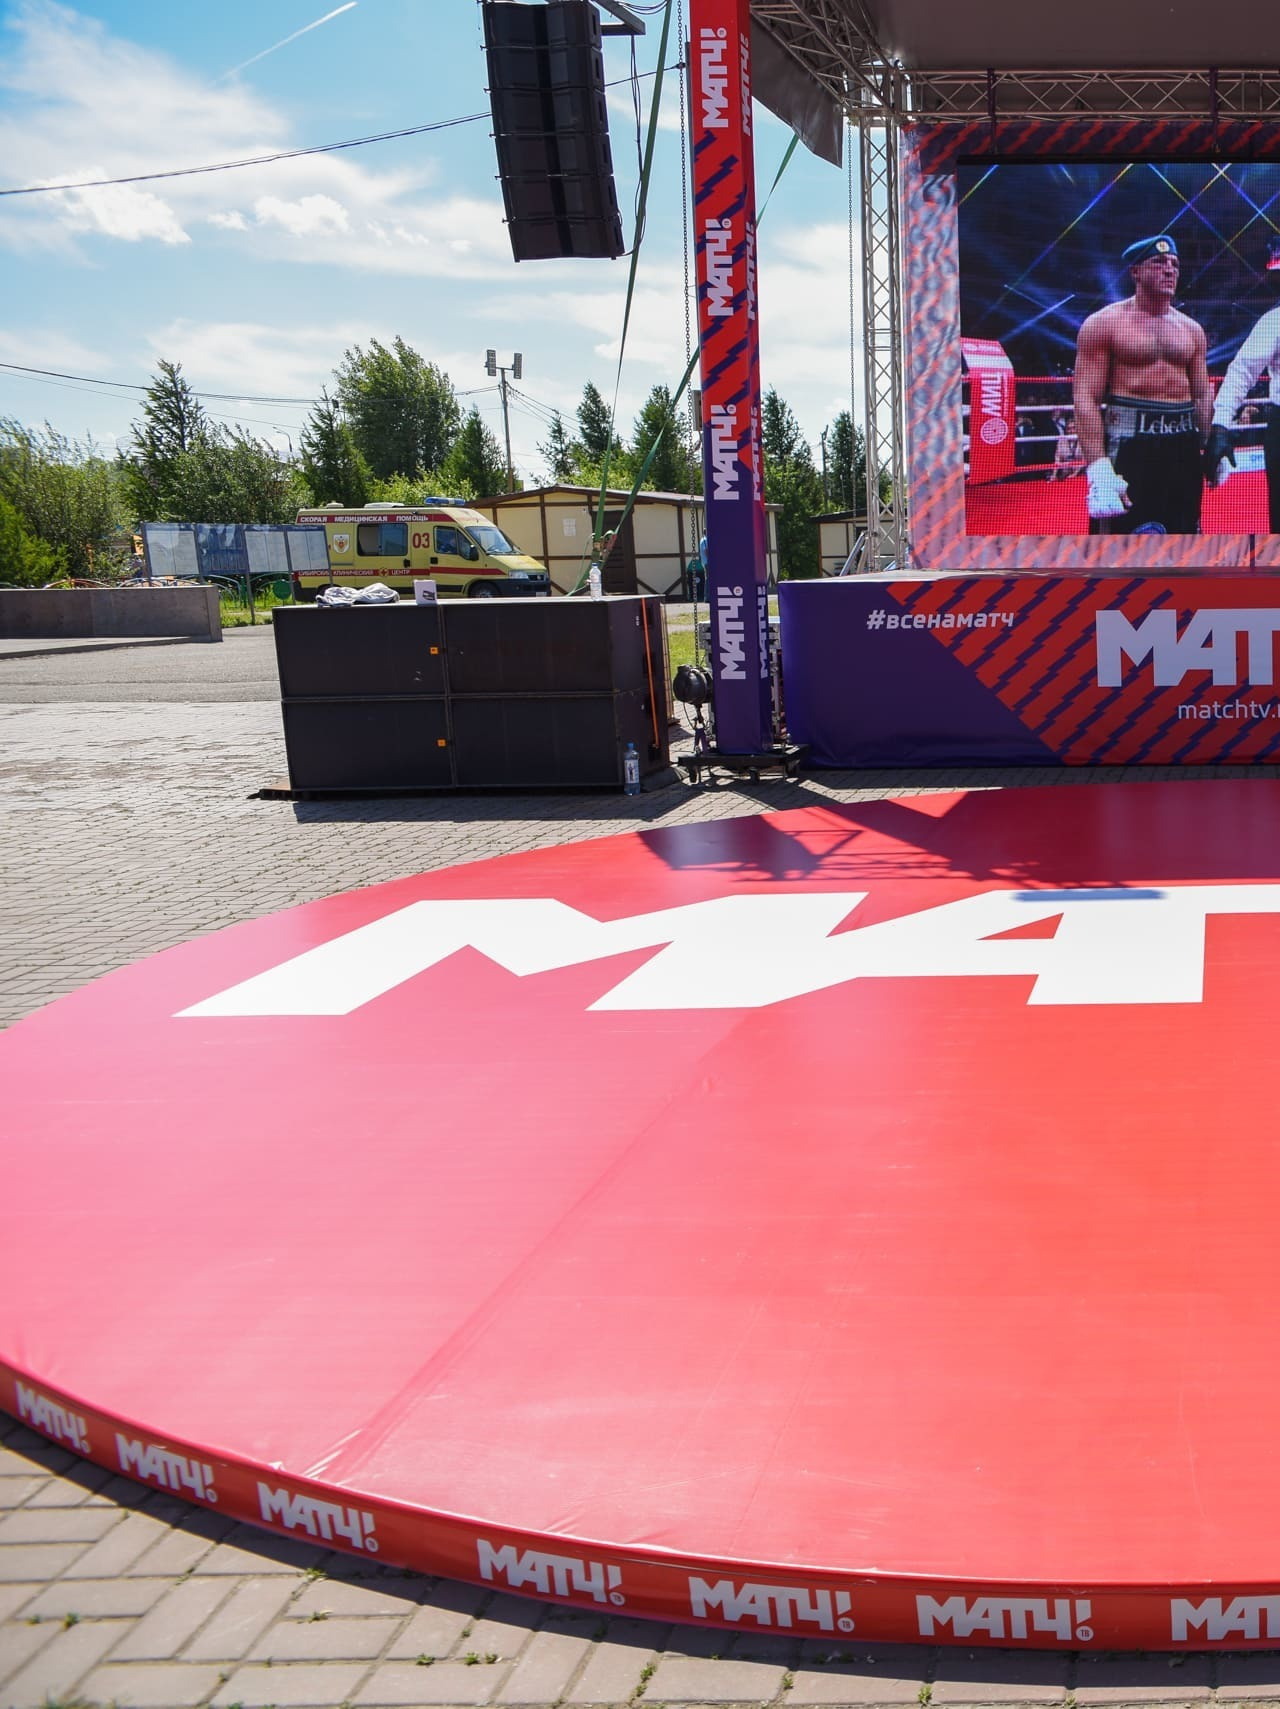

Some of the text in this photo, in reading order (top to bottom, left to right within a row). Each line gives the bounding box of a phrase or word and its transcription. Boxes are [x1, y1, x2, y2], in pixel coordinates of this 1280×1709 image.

[700, 27, 729, 128] МАТЧ!
[706, 218, 734, 316] МАТЧ!
[711, 404, 739, 500] МАТЧ!
[335, 515, 388, 523] МЕДИЦИНСКАЯ
[412, 532, 430, 548] 03
[718, 586, 746, 679] МАТЧ!
[15, 1380, 91, 1454] МАТЧ!
[115, 1433, 218, 1503] МАТЧ!
[256, 1481, 379, 1552] МАТЧ!
[476, 1538, 625, 1606] МАТЧ!
[688, 1576, 855, 1633] МАТЧ!
[916, 1594, 1094, 1641] МАТЧ!
